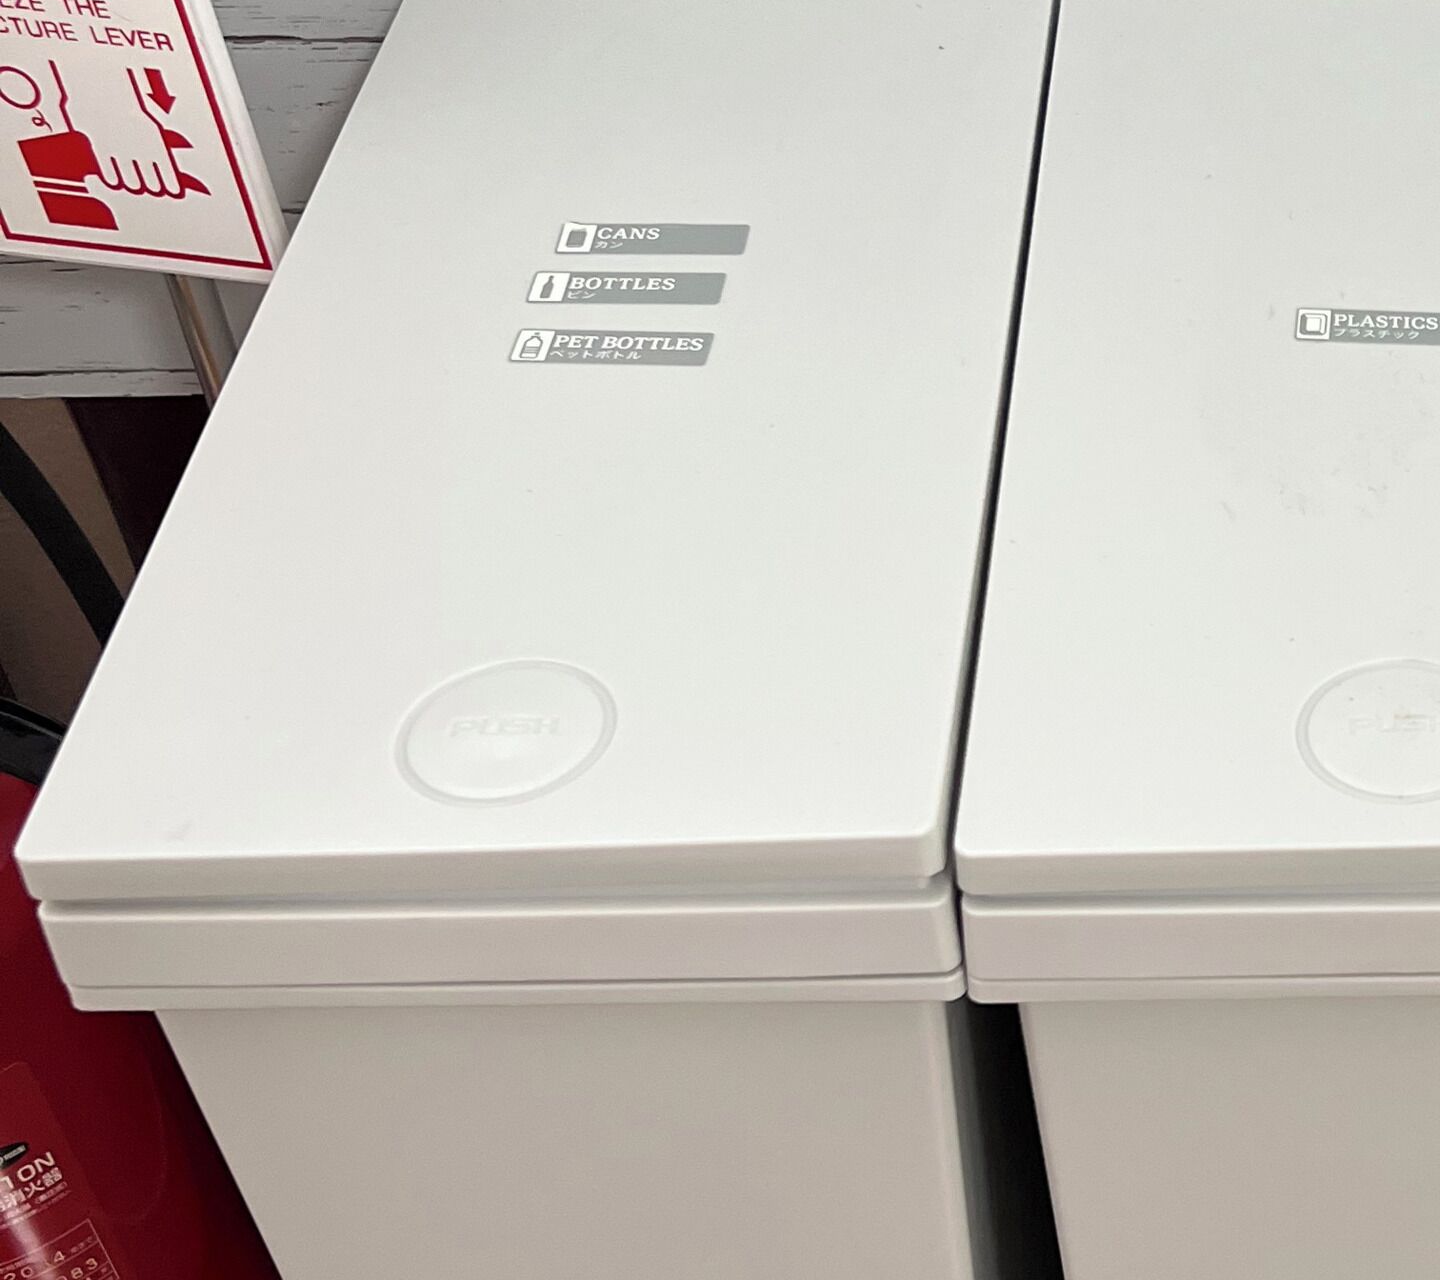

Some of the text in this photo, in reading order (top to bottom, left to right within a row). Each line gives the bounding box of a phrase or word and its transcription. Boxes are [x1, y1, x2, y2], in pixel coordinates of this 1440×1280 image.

[89, 25, 174, 51] LEVER
[596, 227, 661, 240] CANS
[569, 277, 676, 291] BOTTLES
[1333, 313, 1439, 330] PLASTICS
[552, 334, 705, 351] PET BOTTLES
